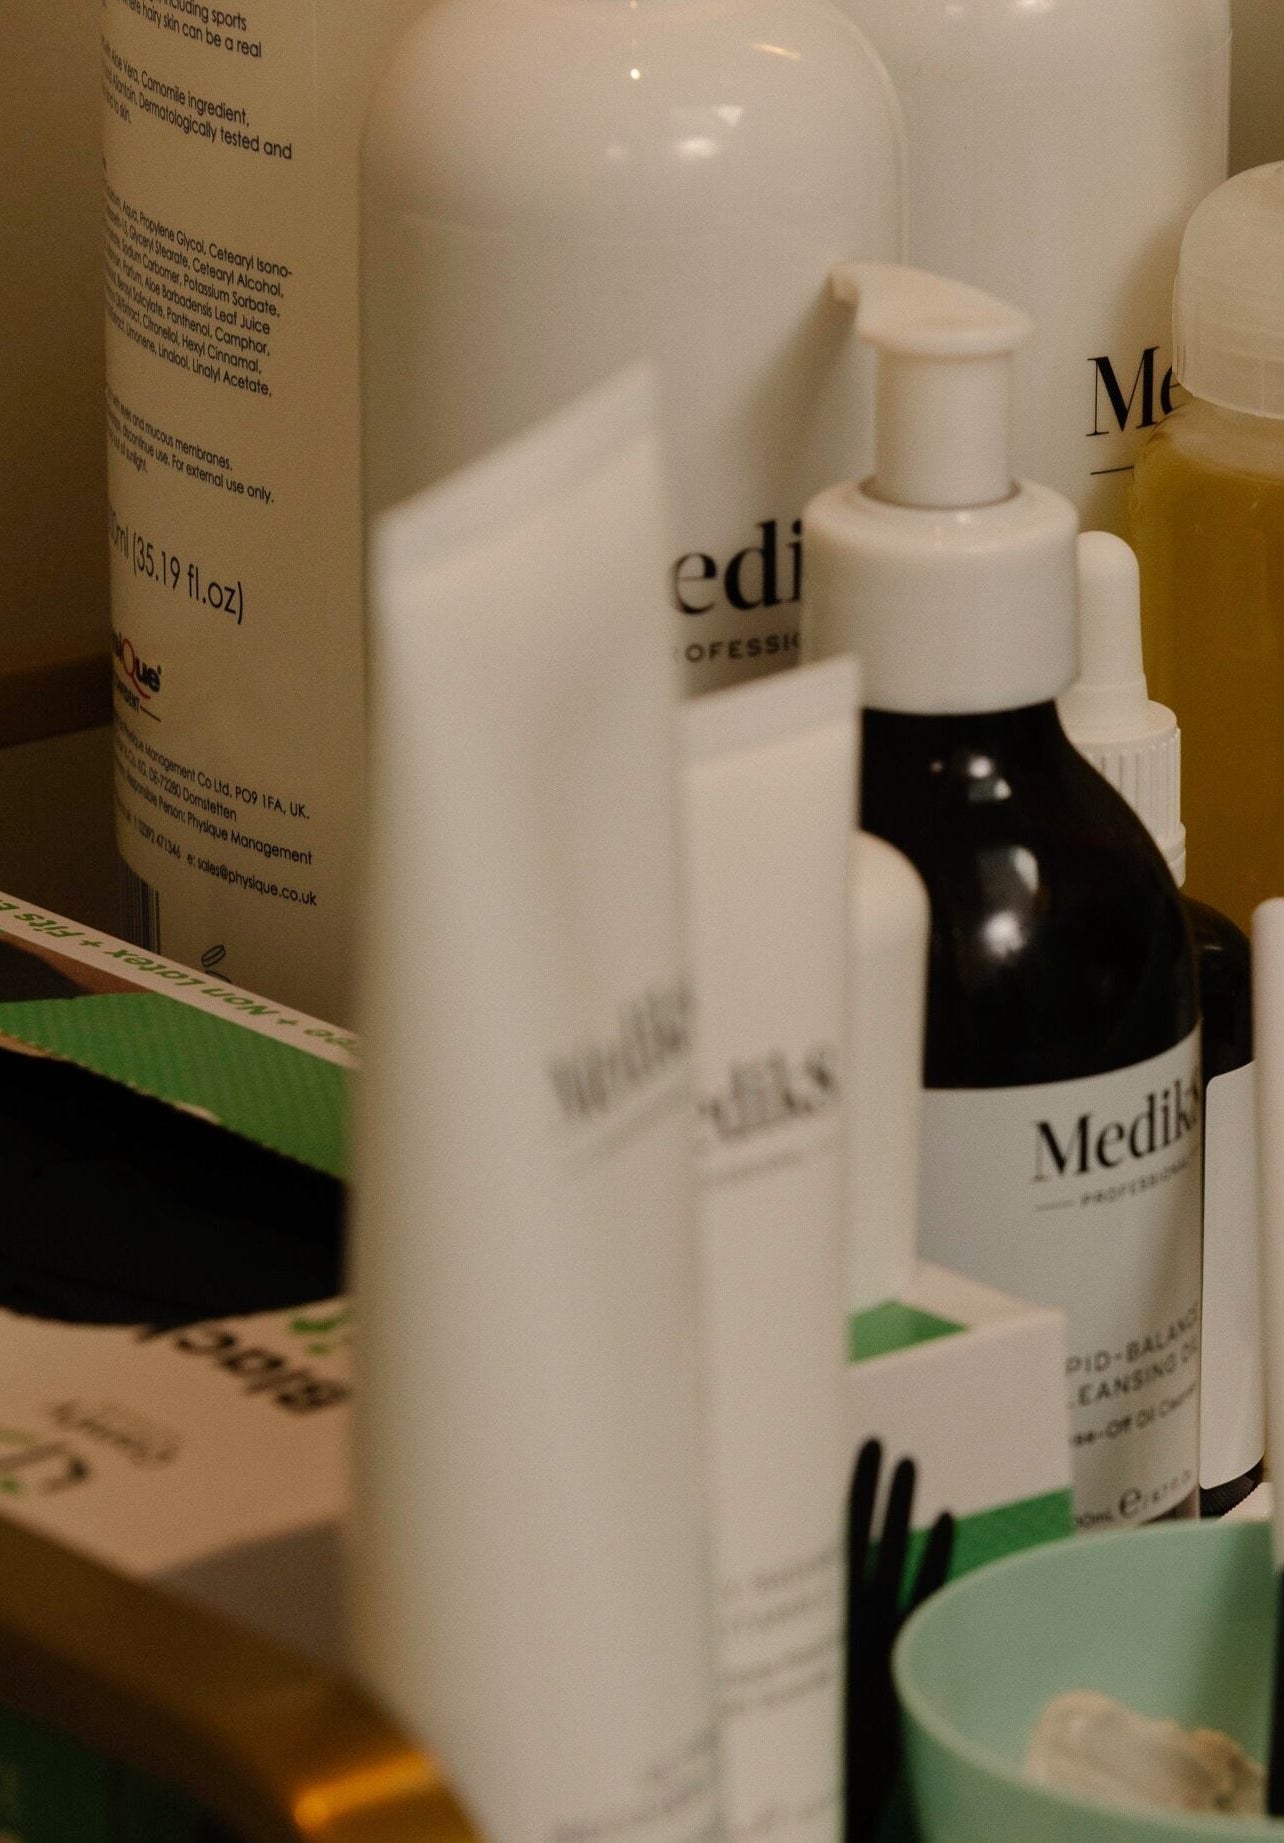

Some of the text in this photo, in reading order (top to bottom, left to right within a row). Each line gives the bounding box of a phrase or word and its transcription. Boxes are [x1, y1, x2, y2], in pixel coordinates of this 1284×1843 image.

[142, 1, 162, 29] hairy
[163, 12, 180, 33] skin
[182, 22, 203, 42] can
[206, 27, 222, 47] be
[225, 38, 234, 51] a
[237, 39, 262, 58] real
[212, 10, 247, 32] sports
[141, 70, 186, 105] Camomile
[139, 91, 217, 143] Dermatologically
[220, 126, 260, 153] tested
[263, 140, 292, 160] and
[140, 210, 175, 242] Propylene
[176, 230, 207, 256] Glycol,
[209, 243, 254, 270] Cetearyl
[257, 256, 292, 279] Isono-
[155, 239, 191, 270] Stearate,
[192, 257, 234, 286] Cetearyl
[145, 275, 161, 296] Aloe
[162, 284, 213, 319] Barbadensis
[214, 306, 237, 326] Leaf
[240, 315, 271, 335] Juice
[183, 275, 230, 302] Potassium
[182, 333, 205, 357] Hexyl
[192, 358, 221, 382] Linalyl
[145, 422, 174, 448] mucous
[175, 437, 233, 471] membranes.
[155, 450, 171, 466] use.
[171, 454, 185, 471] For
[186, 464, 224, 489] external
[225, 479, 245, 495] use
[247, 485, 275, 505] only.
[132, 532, 181, 591] (35.19
[187, 563, 244, 626] fl.oz)
[671, 518, 802, 616] edi
[145, 743, 196, 781] Management
[197, 772, 212, 789] Co
[235, 786, 258, 805] PO9
[289, 802, 310, 820] UK.
[187, 810, 228, 842] Physique
[231, 829, 313, 865] Management
[187, 853, 196, 867] e:
[197, 855, 318, 907] sales@physique.co.uk
[14, 912, 86, 939] Fits
[104, 949, 206, 987] Latex
[201, 986, 280, 1016] Non
